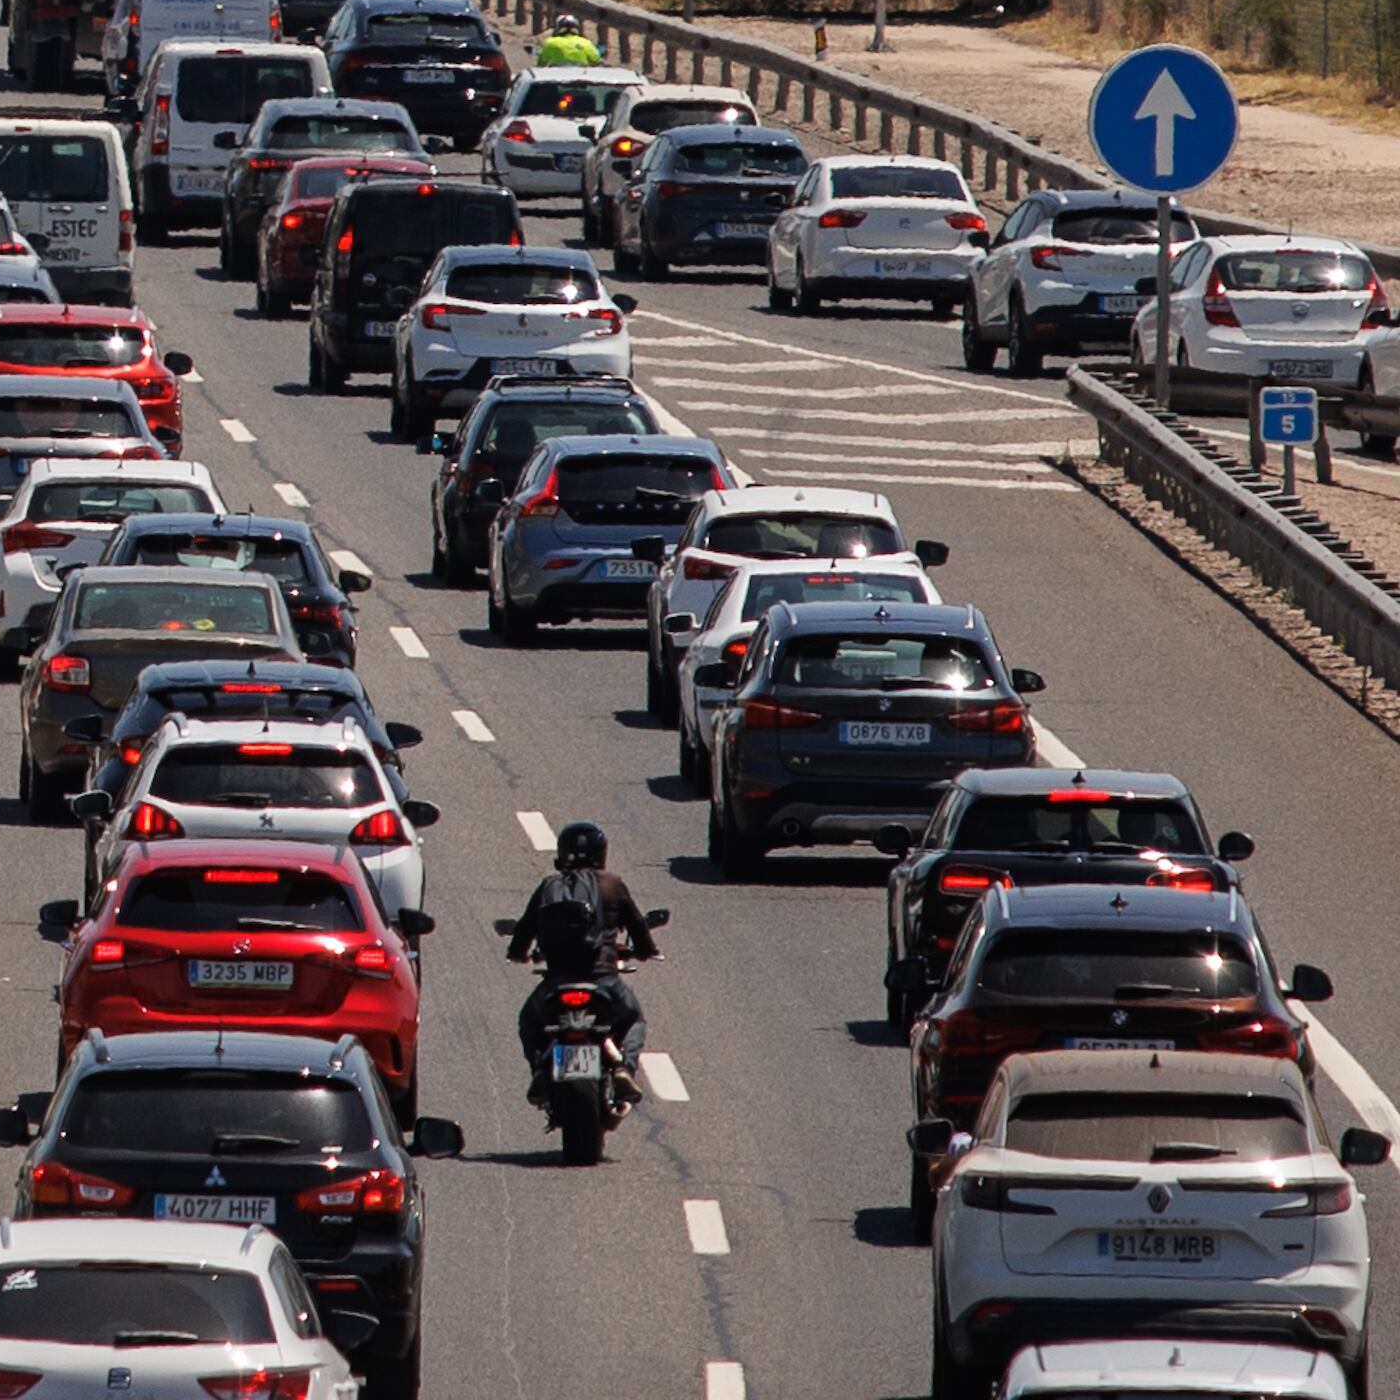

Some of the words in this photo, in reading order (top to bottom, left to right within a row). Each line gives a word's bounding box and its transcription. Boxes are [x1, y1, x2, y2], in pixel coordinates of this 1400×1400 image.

[1282, 415, 1295, 434] 5
[610, 562, 644, 576] 7351
[203, 963, 247, 981] 3235
[253, 964, 289, 982] MBP
[167, 1199, 219, 1219] 4077
[228, 1201, 268, 1221] HHF
[1112, 1236, 1167, 1257] 9148
[1174, 1236, 1215, 1257] MRB
